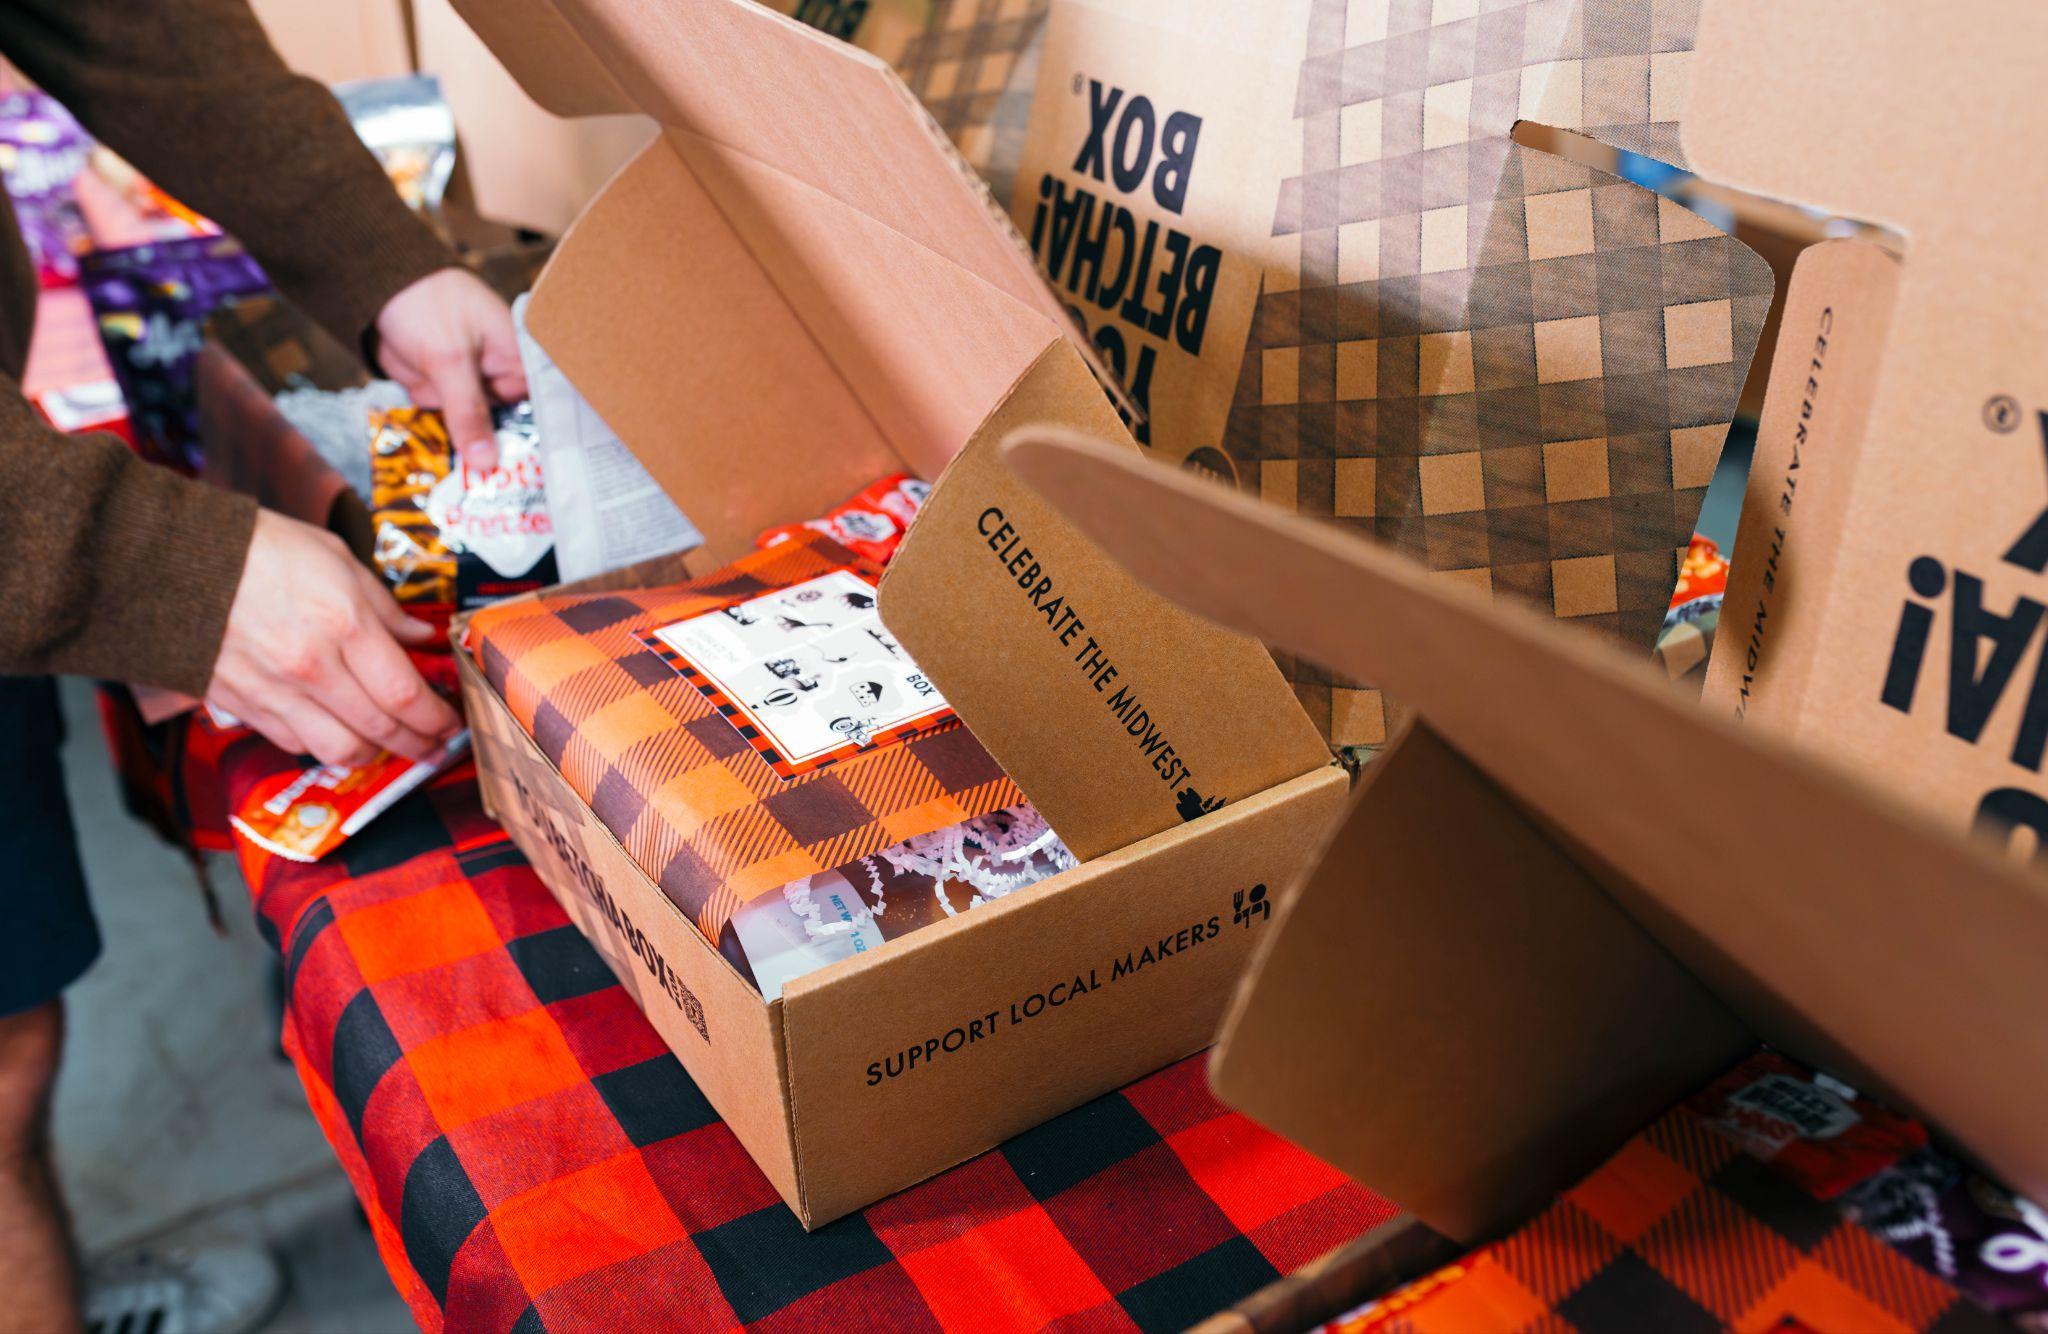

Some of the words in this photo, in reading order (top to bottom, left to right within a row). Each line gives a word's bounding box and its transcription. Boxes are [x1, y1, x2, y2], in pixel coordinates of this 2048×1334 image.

[1029, 173, 1222, 357] BETCHA!
[1780, 306, 1833, 517] CELEBRATE
[977, 507, 1085, 647] CELEBRATE
[1075, 636, 1118, 692] THE
[1106, 685, 1192, 790] MIDWEST
[1763, 527, 1785, 595] THE
[905, 672, 937, 698] BOX
[866, 1011, 999, 1087] SUPPORT
[1010, 969, 1101, 1025] LOCAL
[1111, 916, 1220, 982] MAKERS
